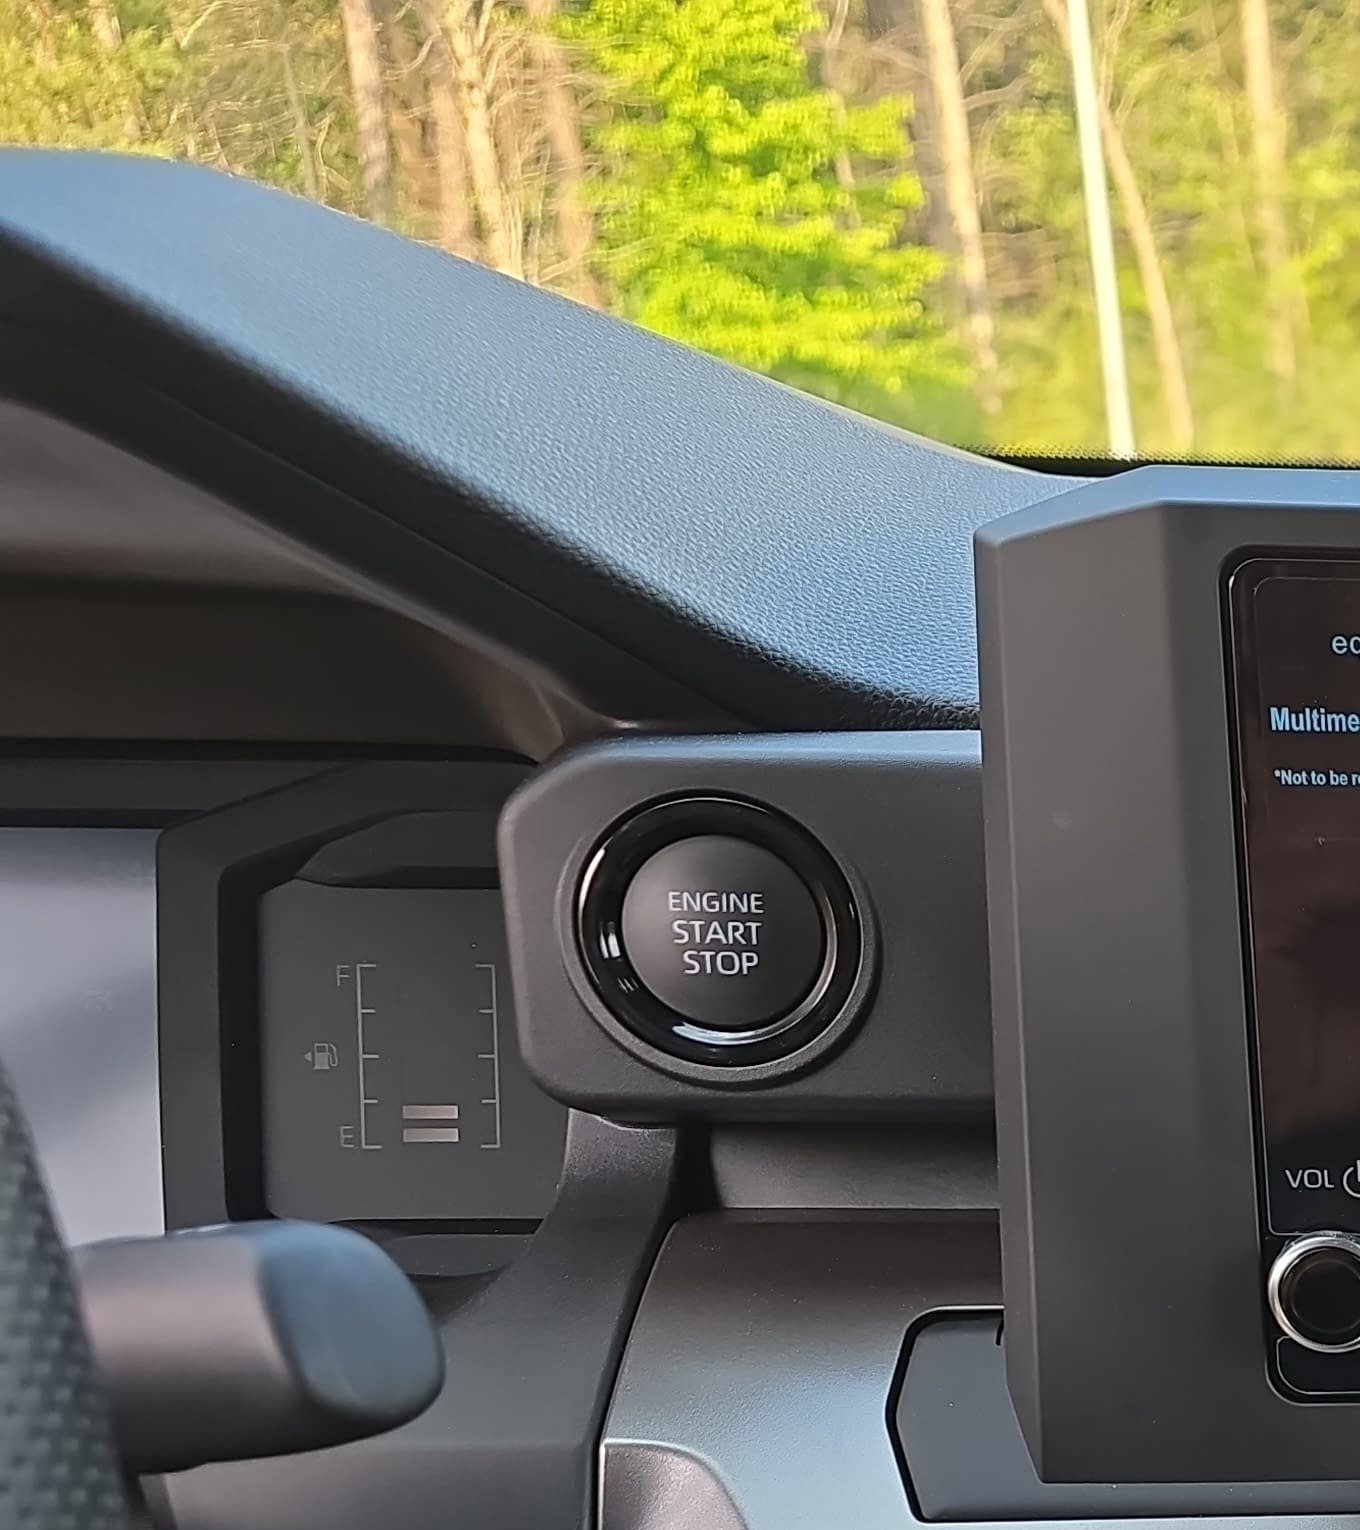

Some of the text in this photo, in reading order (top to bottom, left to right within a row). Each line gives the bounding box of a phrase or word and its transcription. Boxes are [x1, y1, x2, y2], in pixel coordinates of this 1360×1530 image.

[1310, 771, 1327, 787] to
[1329, 770, 1348, 786] be
[667, 890, 764, 915] ENGINE
[671, 919, 763, 946] START
[681, 949, 760, 976] STOP
[335, 964, 350, 988] F
[340, 1124, 354, 1147] E
[1285, 1167, 1335, 1191] VOL
